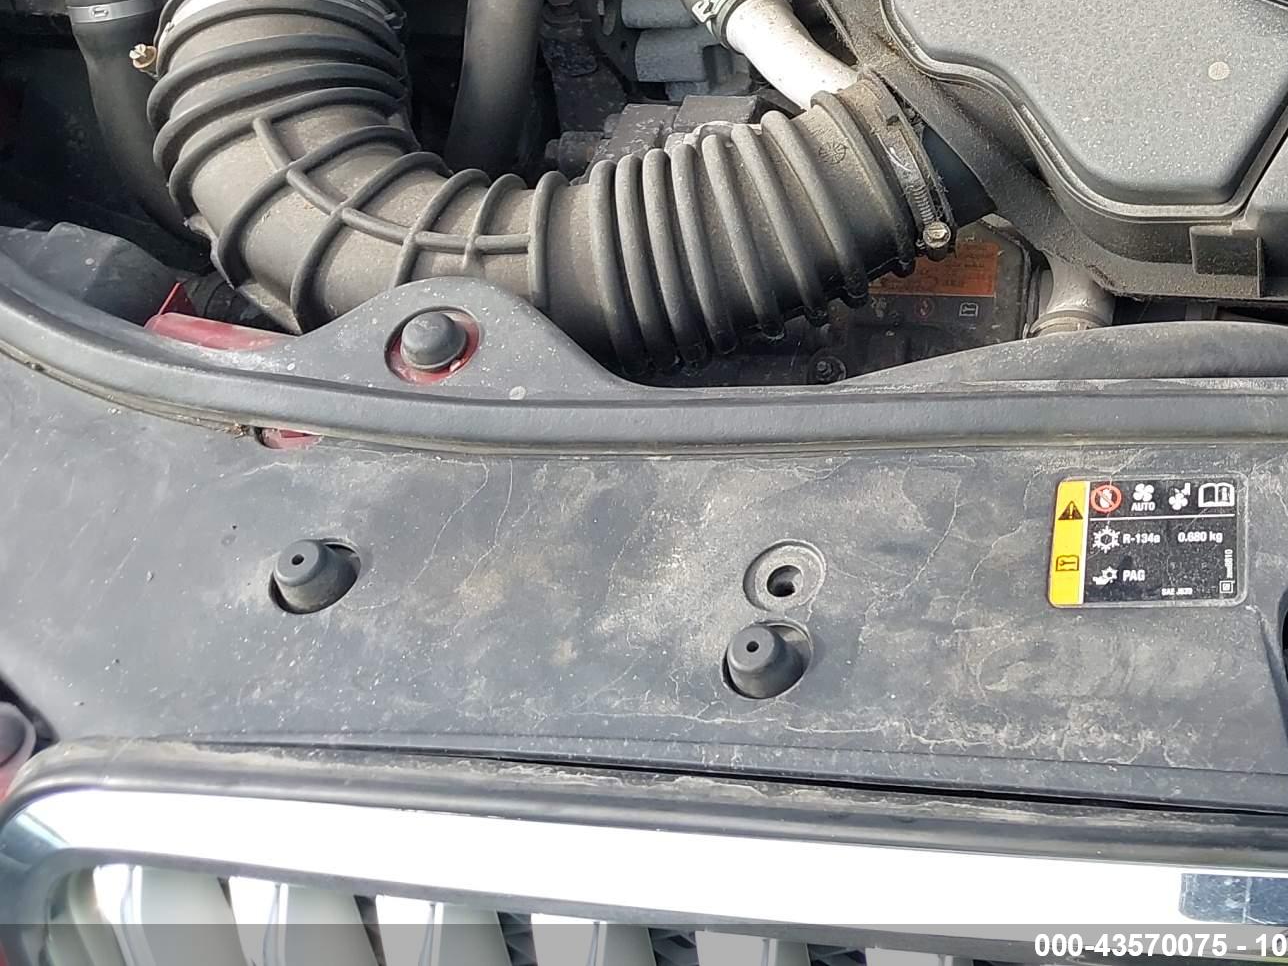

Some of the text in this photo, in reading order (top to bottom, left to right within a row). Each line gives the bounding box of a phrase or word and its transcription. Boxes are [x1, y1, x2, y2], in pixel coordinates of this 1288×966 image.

[1131, 502, 1155, 511] AUTO
[1122, 532, 1160, 544] R-134a
[1209, 531, 1223, 543] kg
[1122, 570, 1145, 581] PAG
